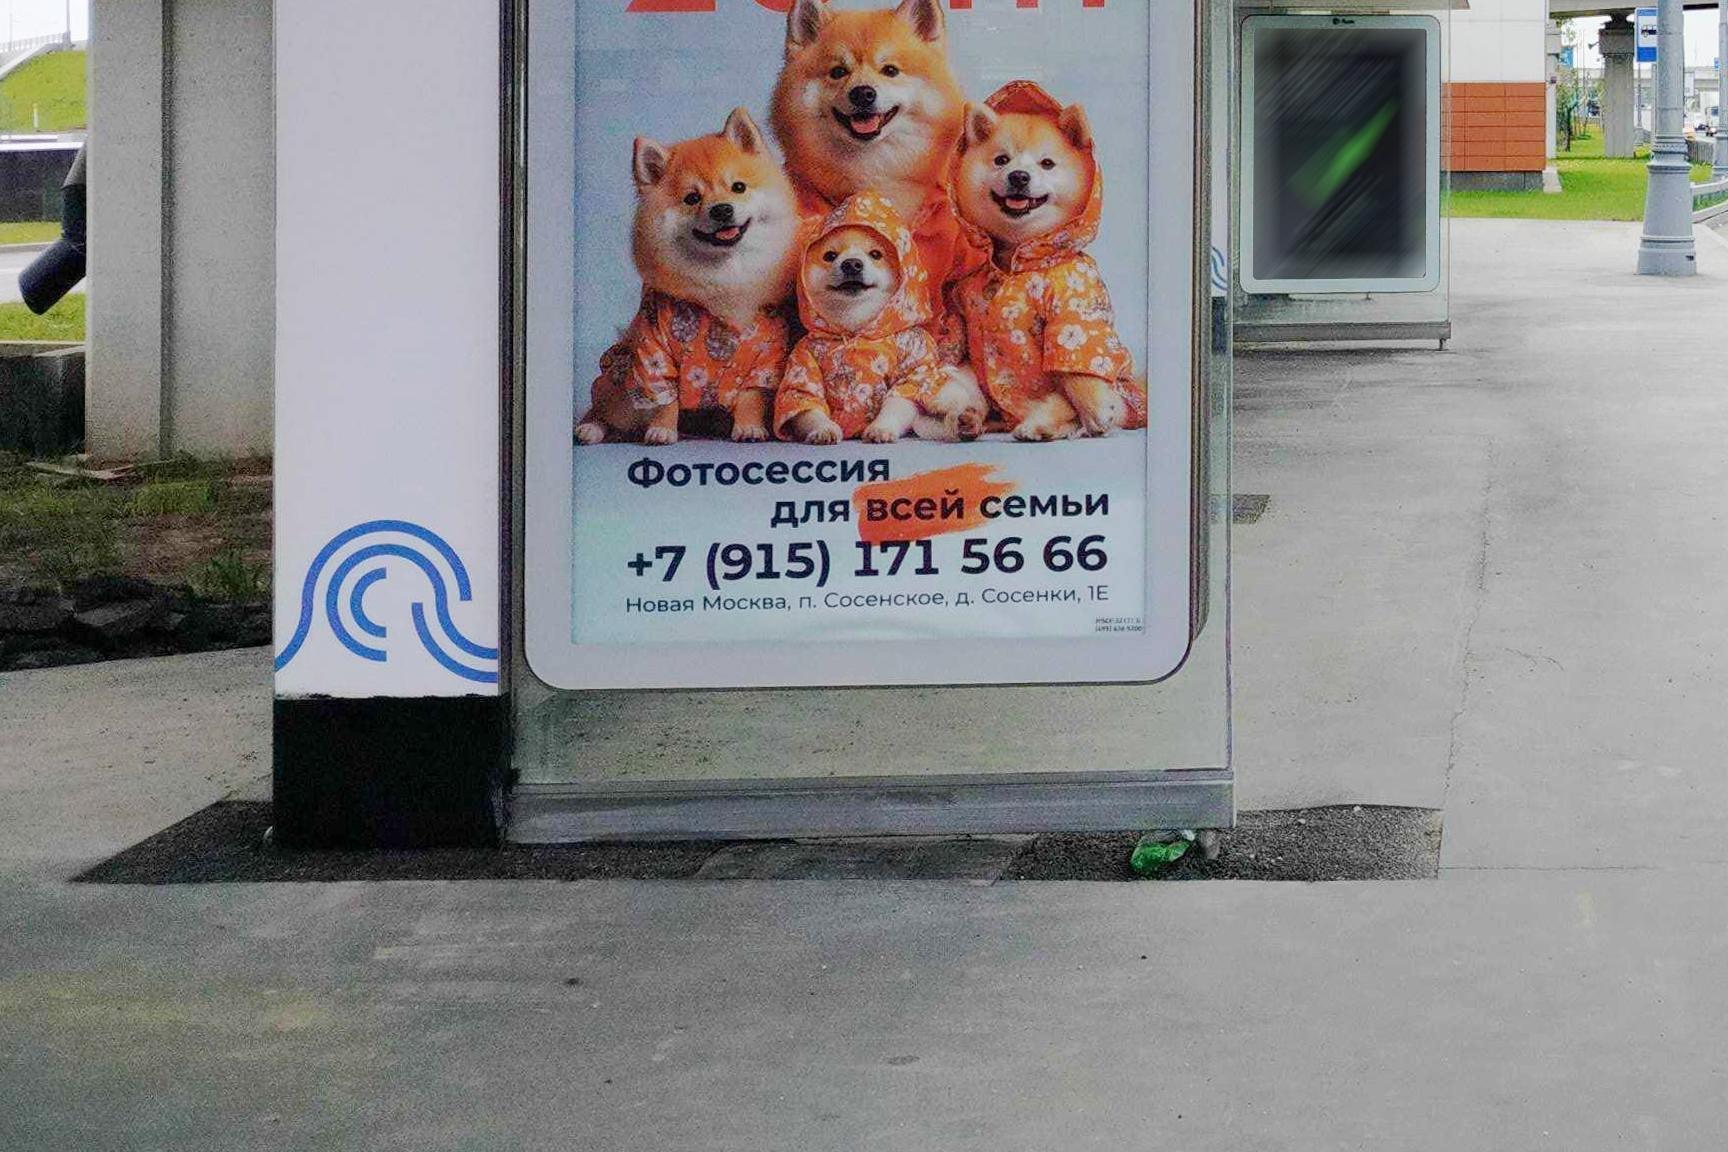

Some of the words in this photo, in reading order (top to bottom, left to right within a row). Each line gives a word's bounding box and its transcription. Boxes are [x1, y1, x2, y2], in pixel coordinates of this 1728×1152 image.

[626, 457, 891, 490] Фотосессия
[770, 499, 851, 529] для
[866, 489, 965, 522] всей
[980, 493, 1110, 520] семьи
[626, 545, 687, 583] +7
[706, 538, 832, 591] (915)
[853, 540, 940, 577] 171
[960, 536, 1025, 576] 56
[1042, 534, 1109, 574] 66
[625, 596, 695, 614] Новая
[702, 592, 793, 612] Москва,
[798, 596, 818, 610] п.
[823, 591, 951, 611] Сосенское,
[954, 591, 976, 607] д.
[980, 589, 1083, 606] Сосенки,
